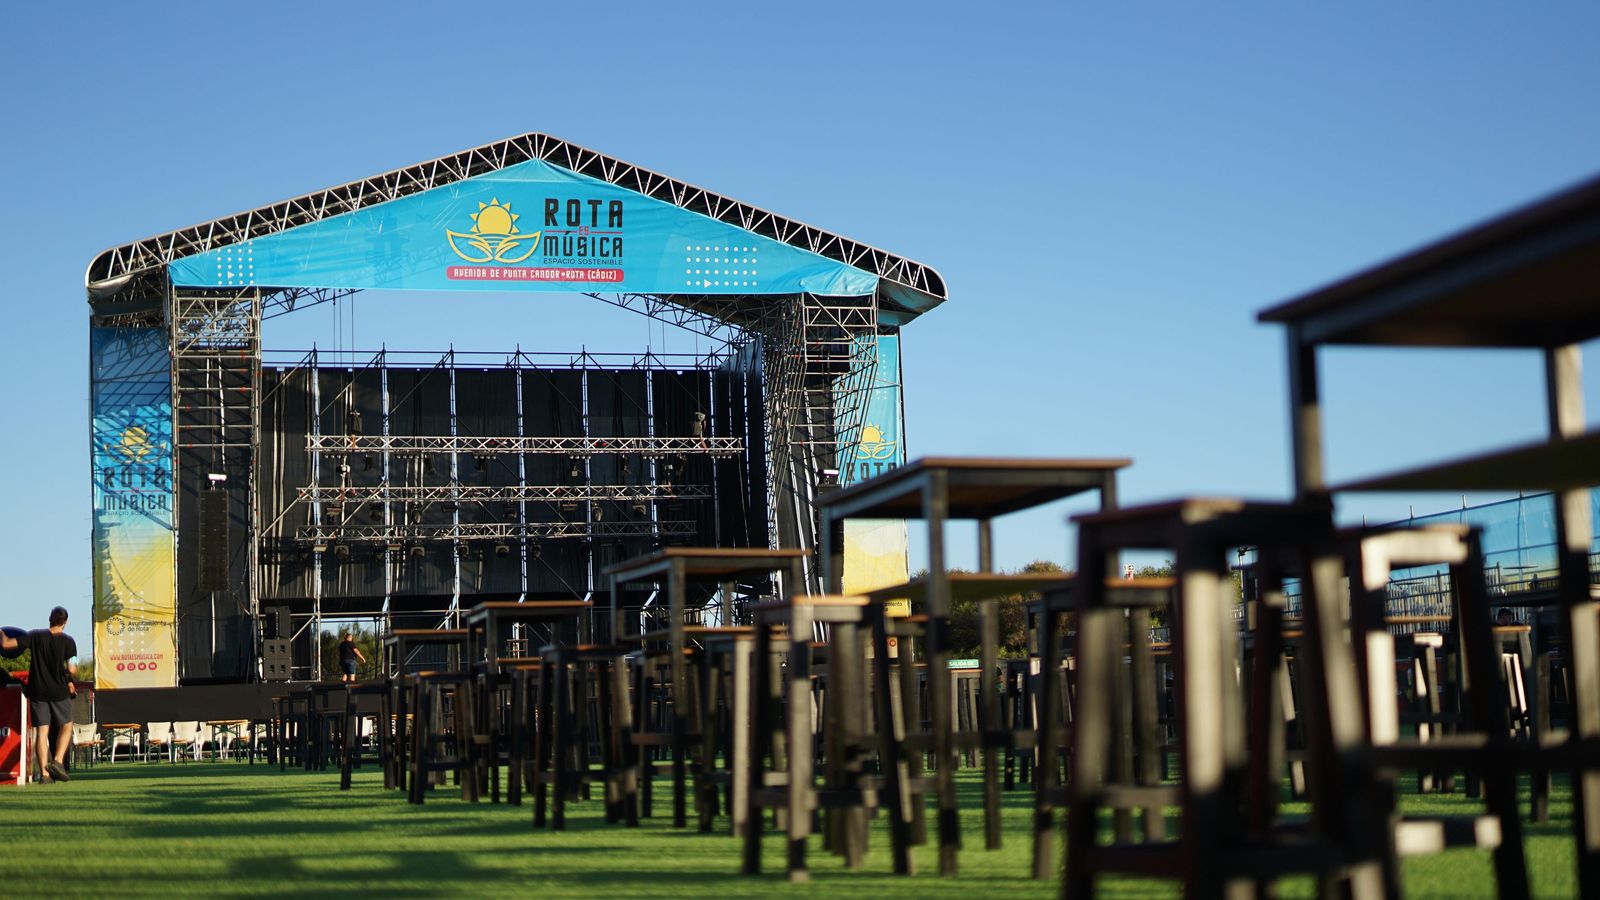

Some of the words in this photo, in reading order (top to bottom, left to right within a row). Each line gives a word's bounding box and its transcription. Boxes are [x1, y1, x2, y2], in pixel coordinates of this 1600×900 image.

[544, 198, 623, 228] ROTA
[578, 225, 589, 236] ES
[543, 230, 623, 258] MÚSICA
[543, 257, 576, 266] ESPACIO
[577, 258, 623, 266] SOSTENIBLE
[453, 268, 487, 278] AVENIDA
[490, 268, 500, 278] DE
[503, 269, 527, 279] PUNTA
[103, 466, 166, 488] ROTA
